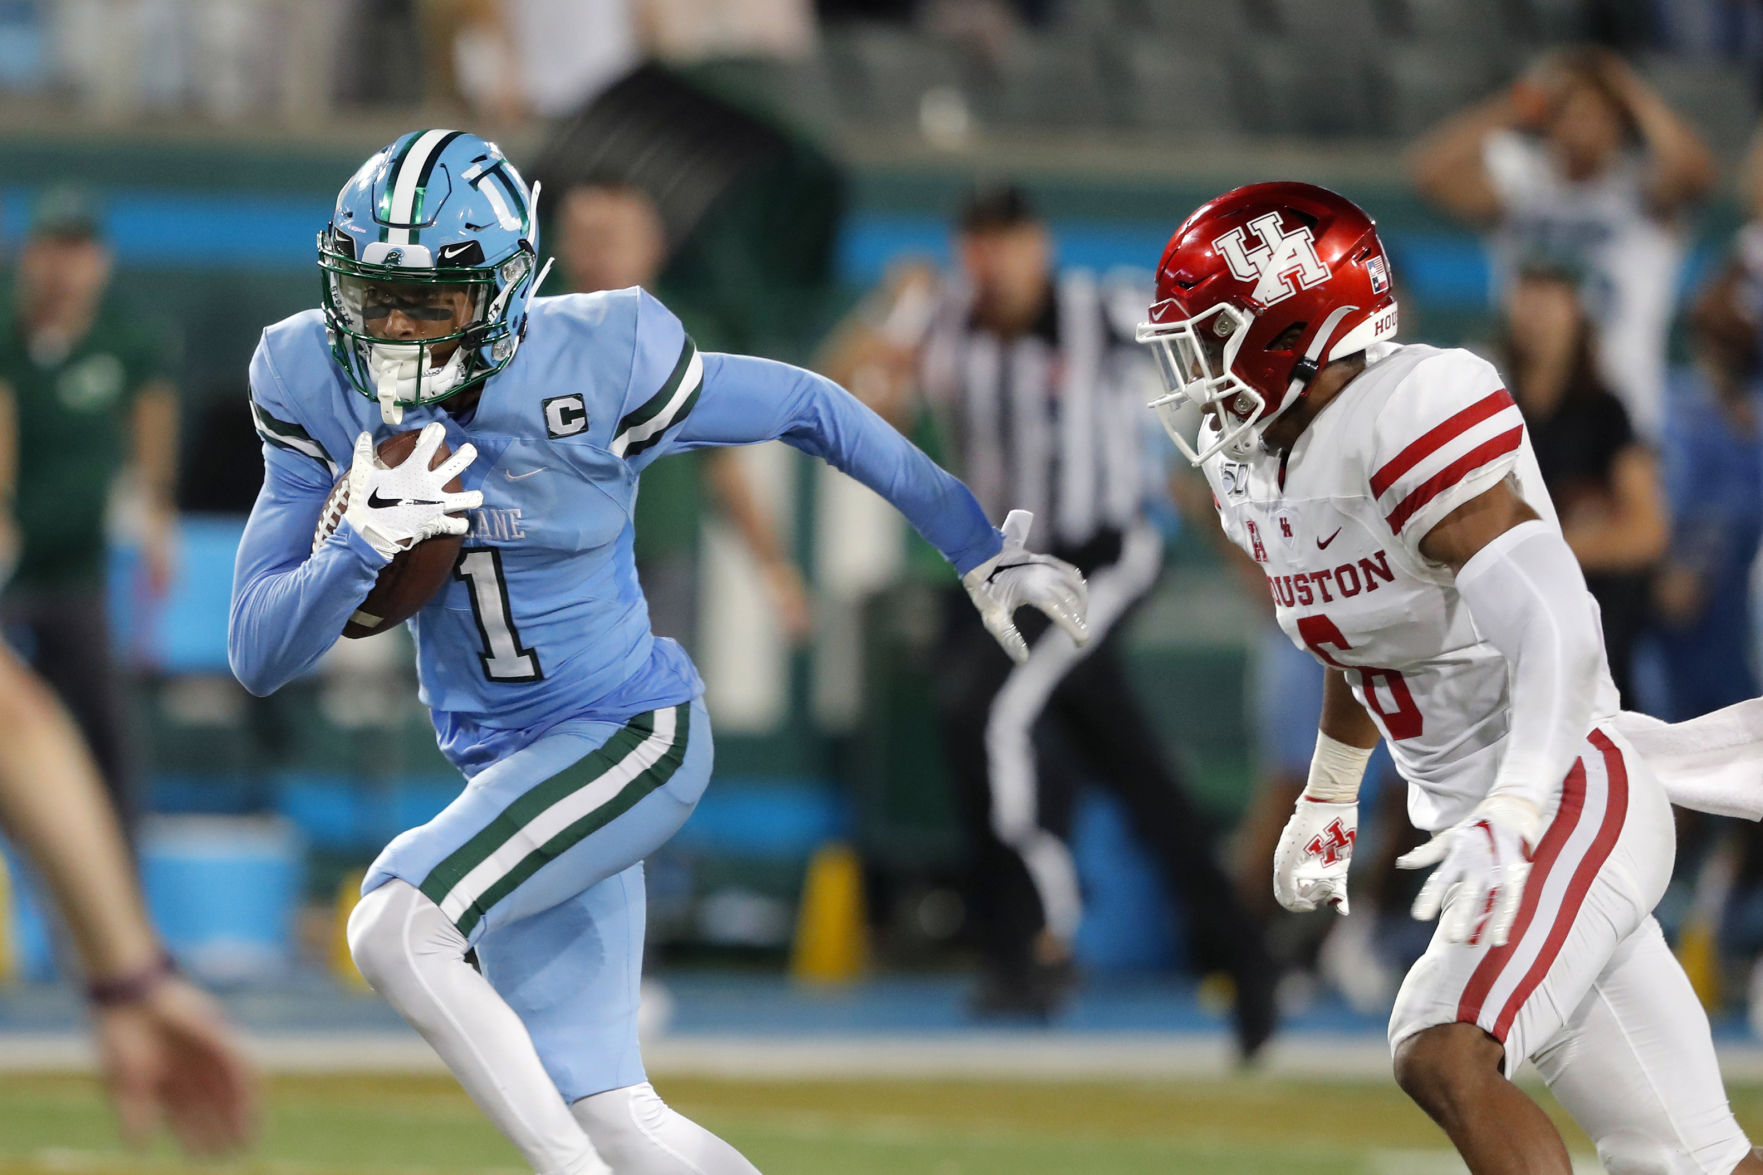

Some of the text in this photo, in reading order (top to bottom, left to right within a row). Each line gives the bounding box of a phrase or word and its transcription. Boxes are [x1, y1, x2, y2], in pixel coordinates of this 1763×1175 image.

[546, 397, 586, 436] C
[452, 546, 546, 682] 1
[1297, 614, 1423, 741] 6
